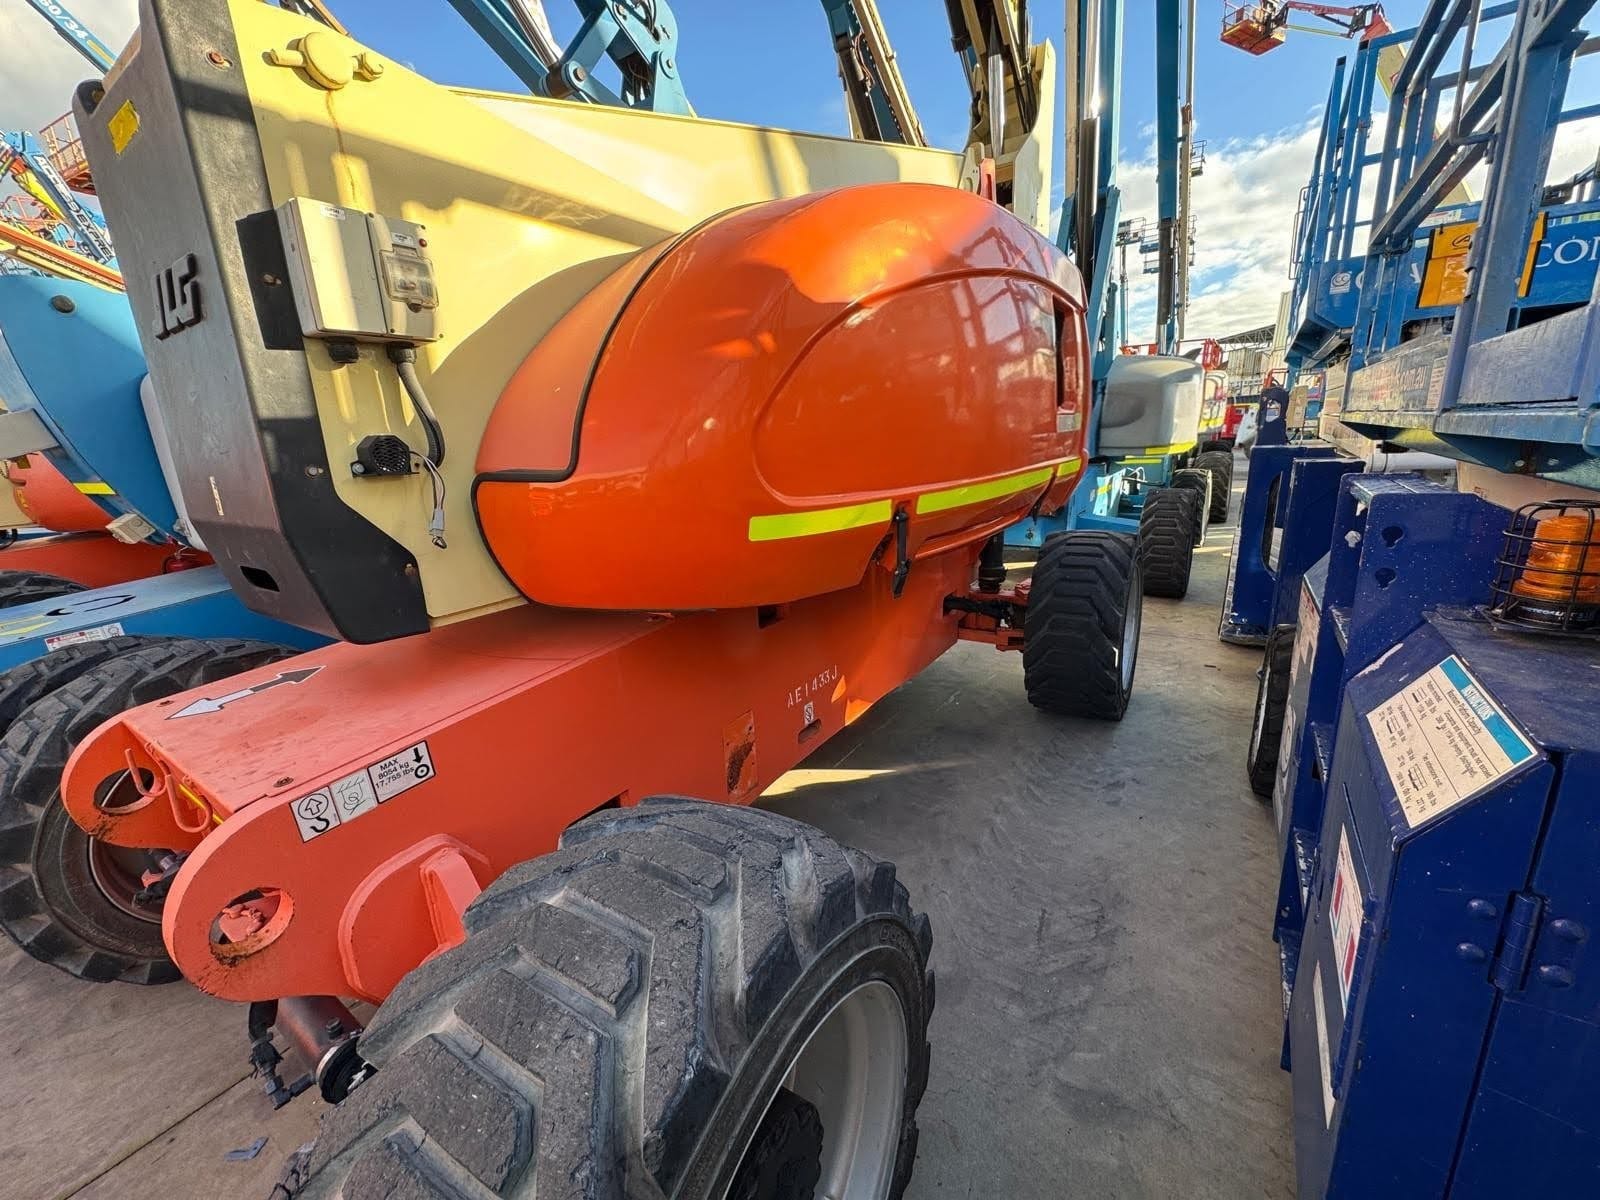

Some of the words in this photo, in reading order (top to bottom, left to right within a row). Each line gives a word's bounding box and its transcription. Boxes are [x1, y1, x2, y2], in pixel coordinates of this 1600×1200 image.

[33, 154, 80, 213] ACCESS
[1465, 716, 1483, 736] Capacity
[378, 767, 398, 780] 8054
[399, 761, 410, 770] kg
[380, 758, 399, 772] MAX
[403, 766, 415, 776] lbs
